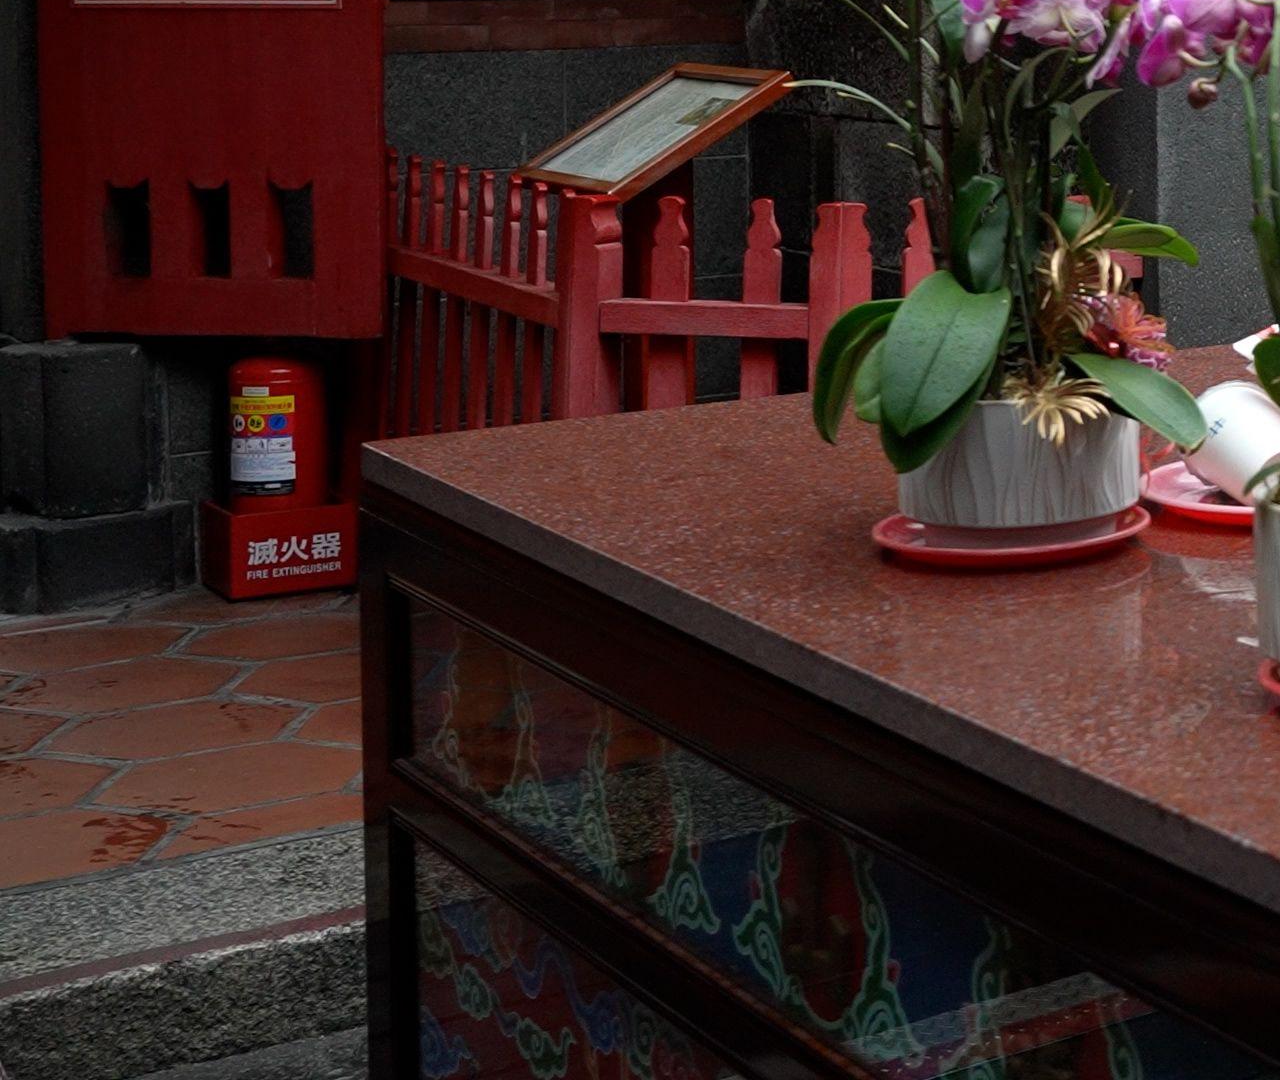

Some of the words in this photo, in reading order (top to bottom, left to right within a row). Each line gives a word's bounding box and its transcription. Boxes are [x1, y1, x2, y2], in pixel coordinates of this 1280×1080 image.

[247, 531, 342, 566] 滅火器
[246, 569, 269, 581] FIRE
[272, 561, 342, 578] EXTINGUISHER
